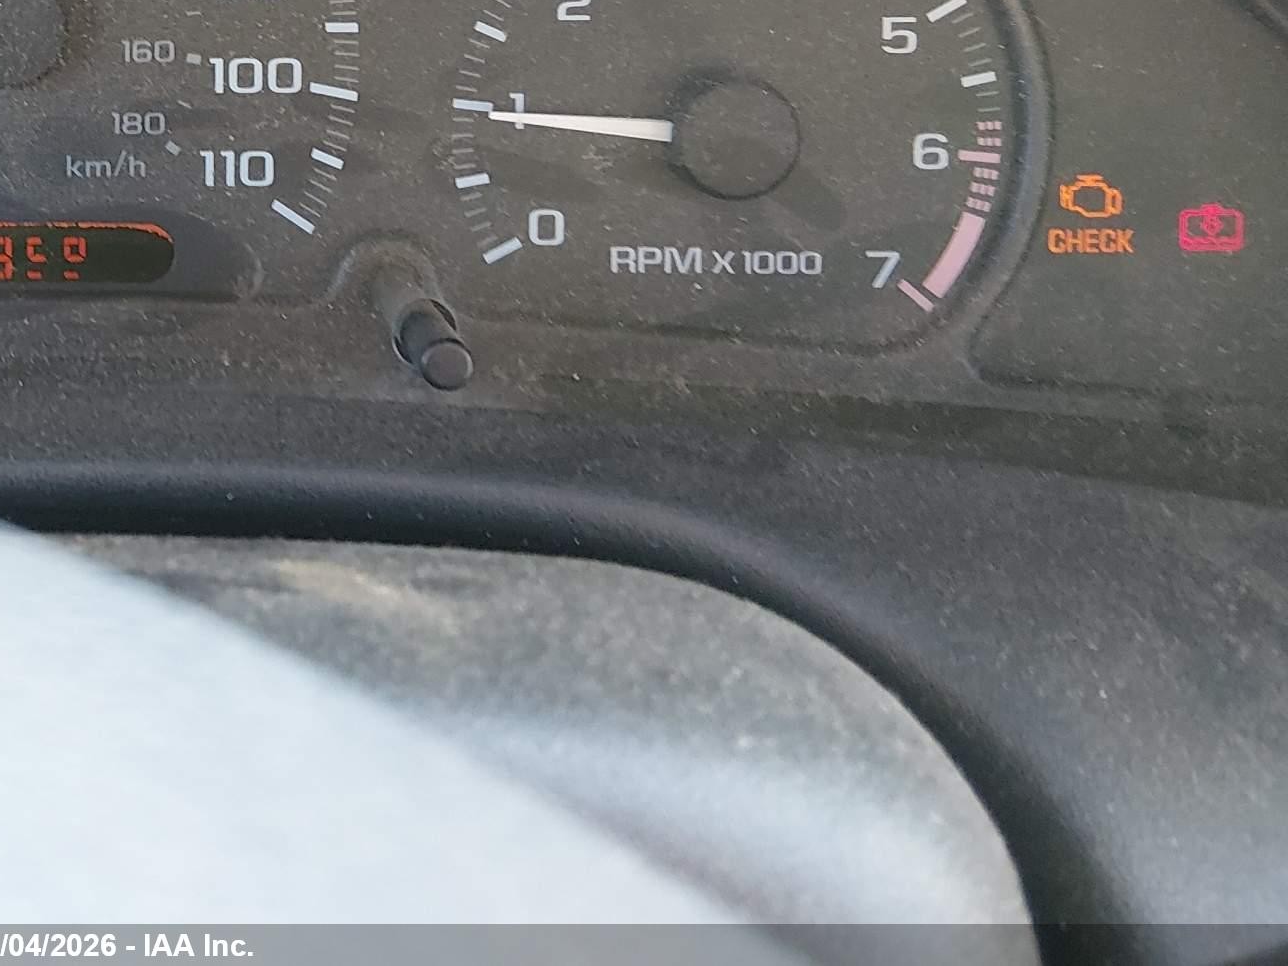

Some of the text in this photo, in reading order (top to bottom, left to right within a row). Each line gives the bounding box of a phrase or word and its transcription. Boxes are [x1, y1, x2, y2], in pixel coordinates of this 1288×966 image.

[122, 40, 175, 63] 160
[882, 17, 917, 54] 5
[210, 58, 302, 93] 100
[112, 112, 165, 134] 180
[509, 93, 525, 129] 1
[66, 155, 146, 180] km/h
[200, 150, 275, 186] 110
[913, 135, 950, 170] 6
[529, 210, 564, 246] 0
[1047, 228, 1135, 253] CHECK
[610, 247, 702, 275] RPM
[743, 250, 822, 275] 1000
[866, 252, 900, 288] 7
